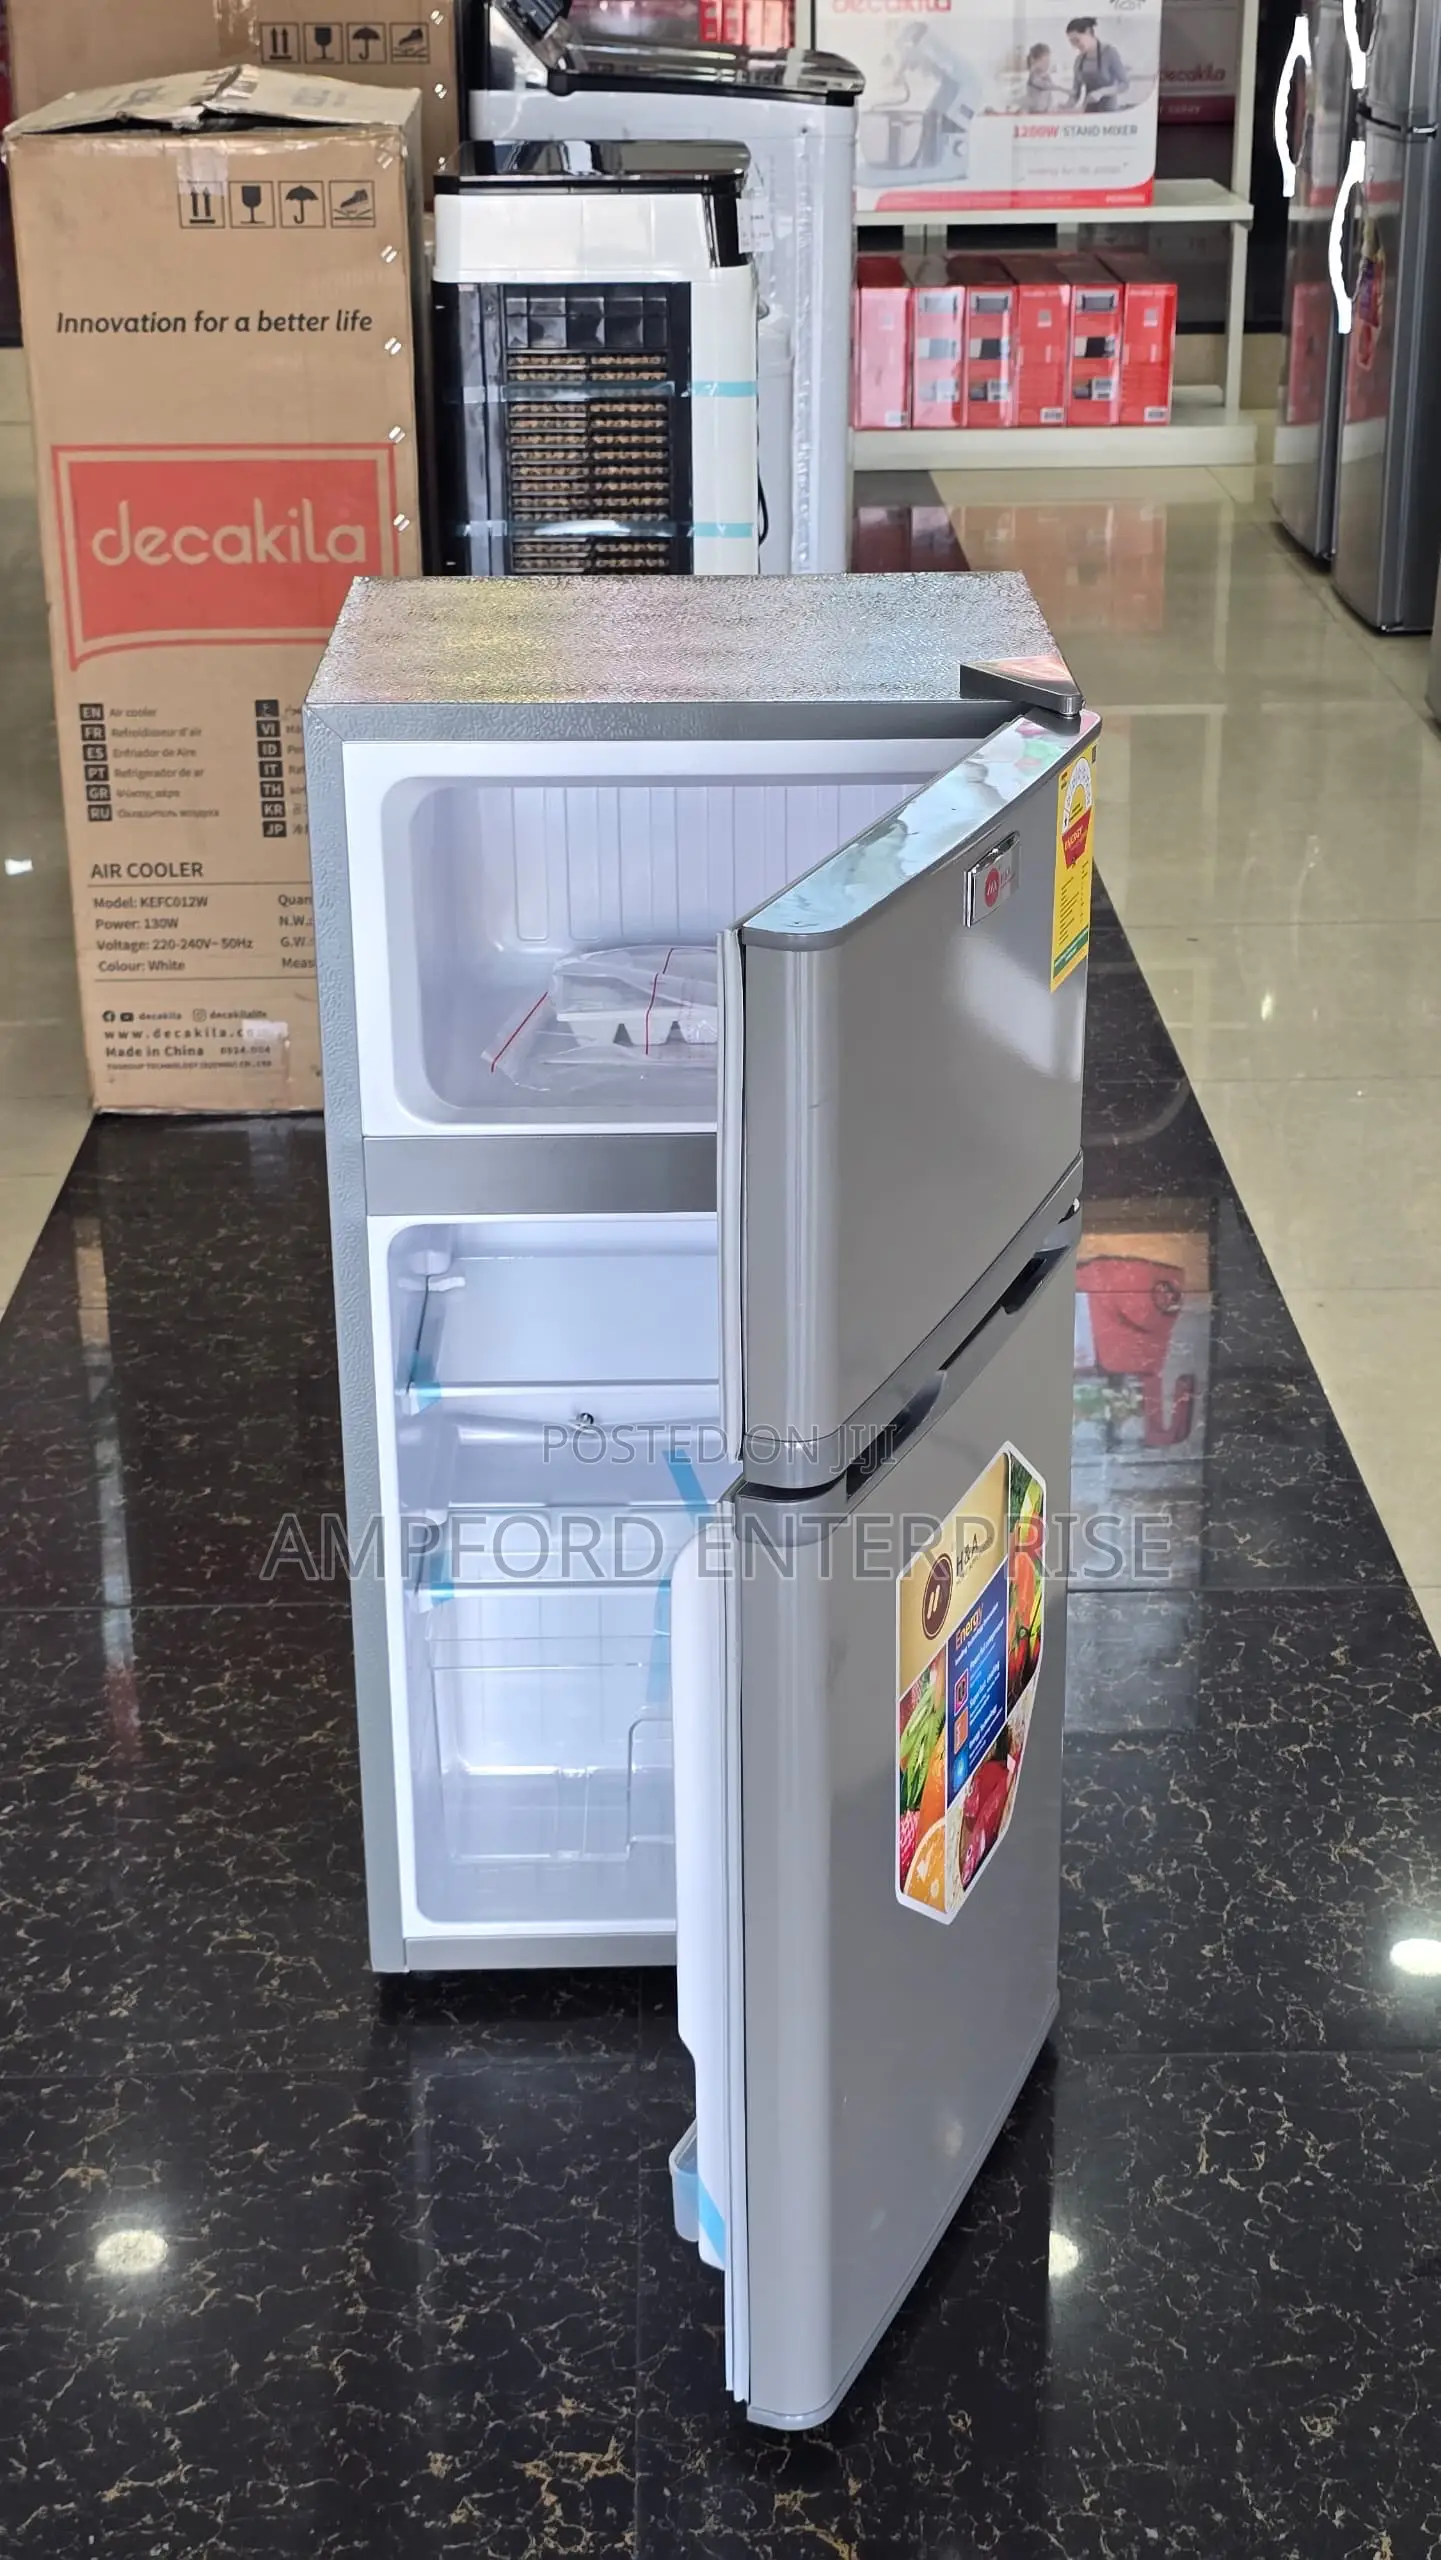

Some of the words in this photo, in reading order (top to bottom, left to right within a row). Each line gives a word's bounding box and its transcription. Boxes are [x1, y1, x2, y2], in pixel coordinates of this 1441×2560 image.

[1063, 124, 1101, 137] STAND
[1102, 123, 1139, 136] MIXER
[57, 311, 187, 333] Innovation
[194, 309, 229, 333] for
[235, 315, 250, 332] a
[257, 310, 330, 332] better
[336, 309, 373, 332] life
[91, 497, 367, 567] decakila
[82, 707, 102, 719] EN
[125, 706, 157, 718] cooler
[84, 727, 104, 739] FR
[260, 723, 275, 735] VI
[86, 747, 105, 759] ES
[161, 748, 176, 758] de
[261, 744, 277, 756] ID
[87, 767, 106, 780] PT
[179, 768, 193, 779] de
[263, 764, 278, 776] IT
[89, 787, 109, 799] GR
[263, 784, 282, 796] TH
[91, 807, 110, 819] RU
[264, 804, 283, 816] KR
[266, 823, 285, 836] JP
[91, 863, 122, 879] AIR
[126, 862, 204, 878] COOLER
[93, 897, 138, 910] Model:
[140, 896, 208, 908] KEFC012W
[95, 918, 140, 930] Power:
[144, 917, 179, 929] 130W
[96, 939, 150, 953] Voltage:
[98, 960, 145, 972] Colour:
[149, 959, 186, 971] White
[106, 1046, 142, 1058] Made
[146, 1045, 160, 1057] in
[164, 1044, 205, 1057] China
[955, 1601, 984, 1652] Energy
